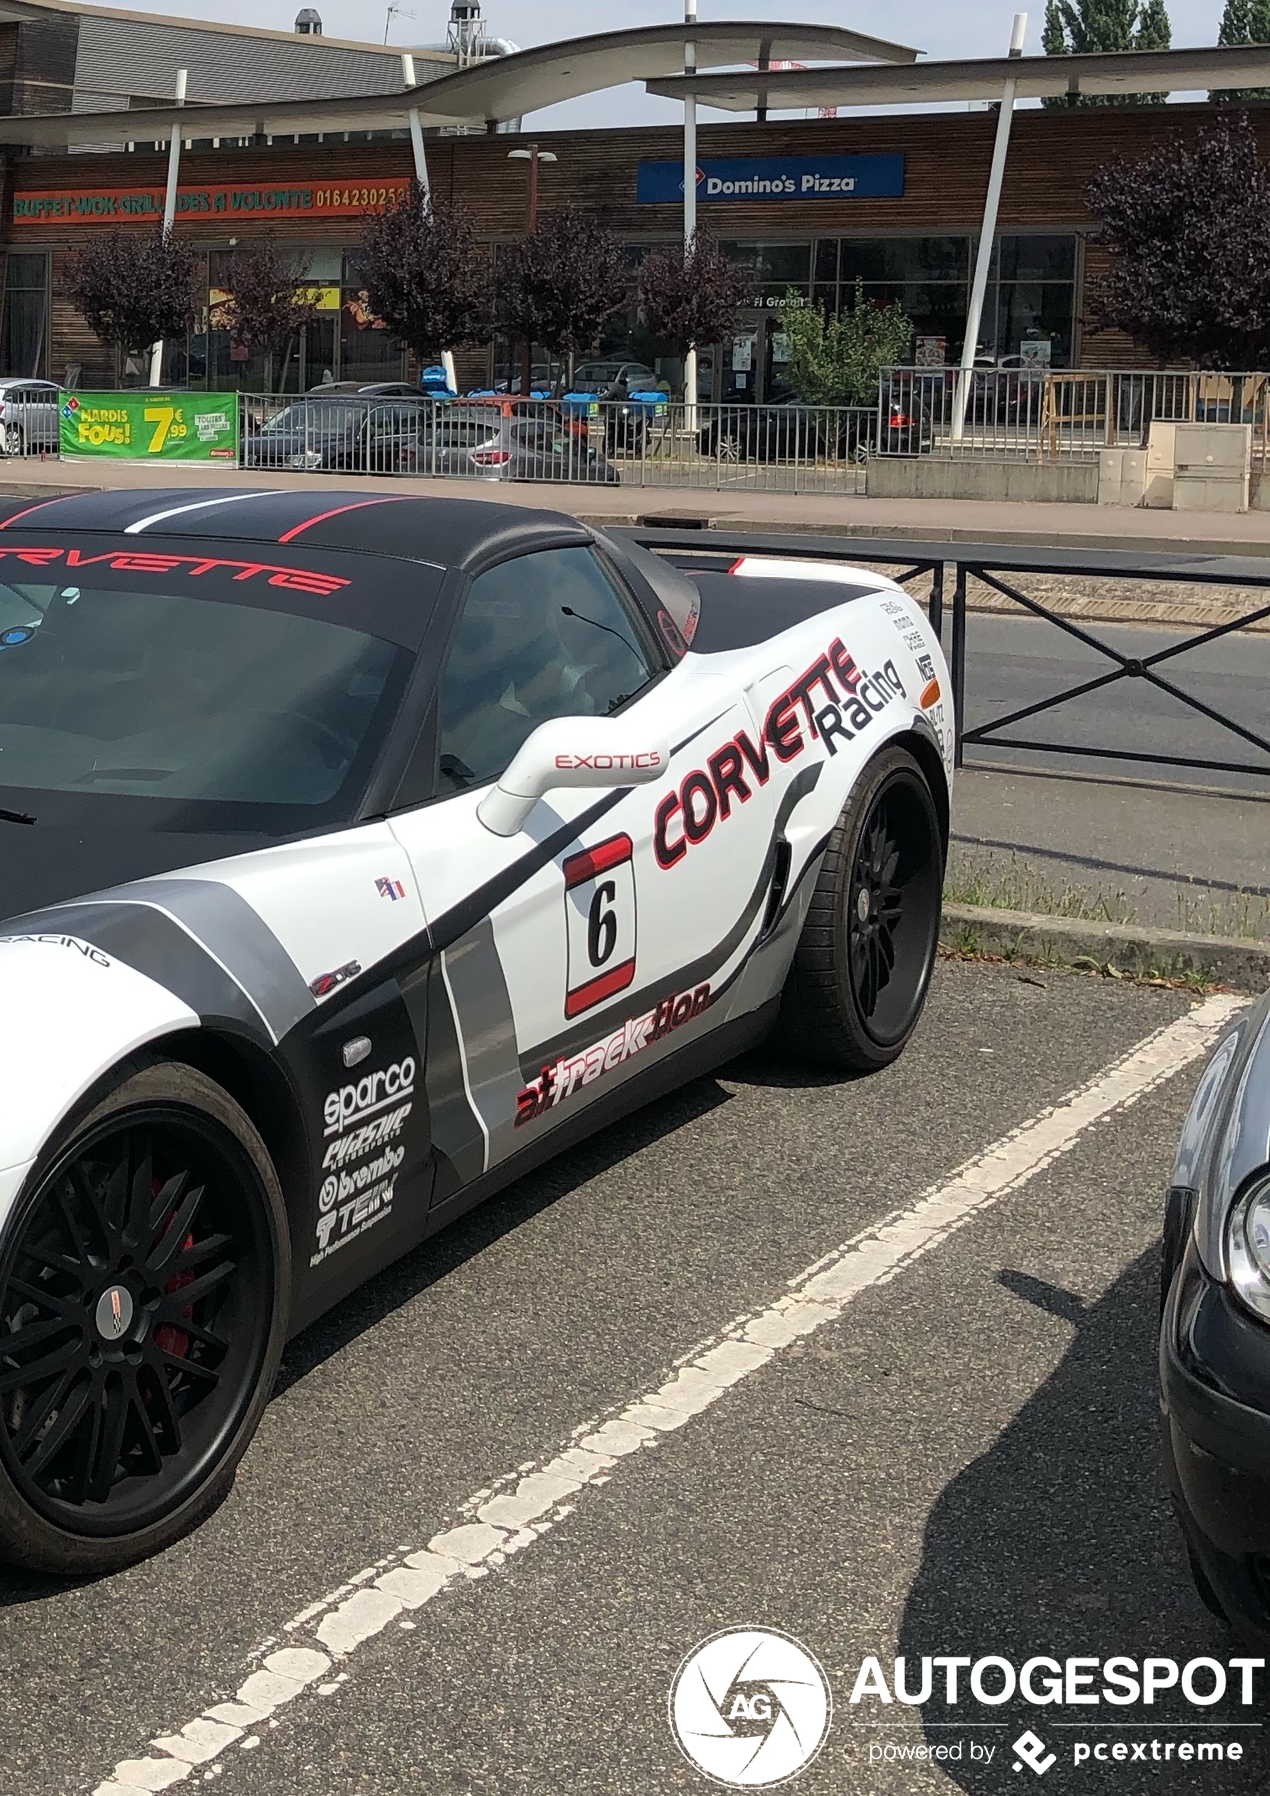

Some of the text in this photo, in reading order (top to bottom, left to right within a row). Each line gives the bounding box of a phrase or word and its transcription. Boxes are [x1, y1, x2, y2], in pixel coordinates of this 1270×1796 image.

[706, 174, 855, 195] Domino's Pizza
[232, 190, 313, 211] VOLONTE
[80, 409, 128, 422] MARDIS
[197, 415, 223, 424] TOUTES
[78, 423, 130, 446] FOUS!
[813, 658, 907, 757] Racing
[555, 751, 661, 769] EXOTICS
[653, 636, 862, 871] CORVETTE
[588, 879, 617, 968] 6
[323, 1056, 416, 1135] sparco
[337, 1145, 405, 1202] brembo
